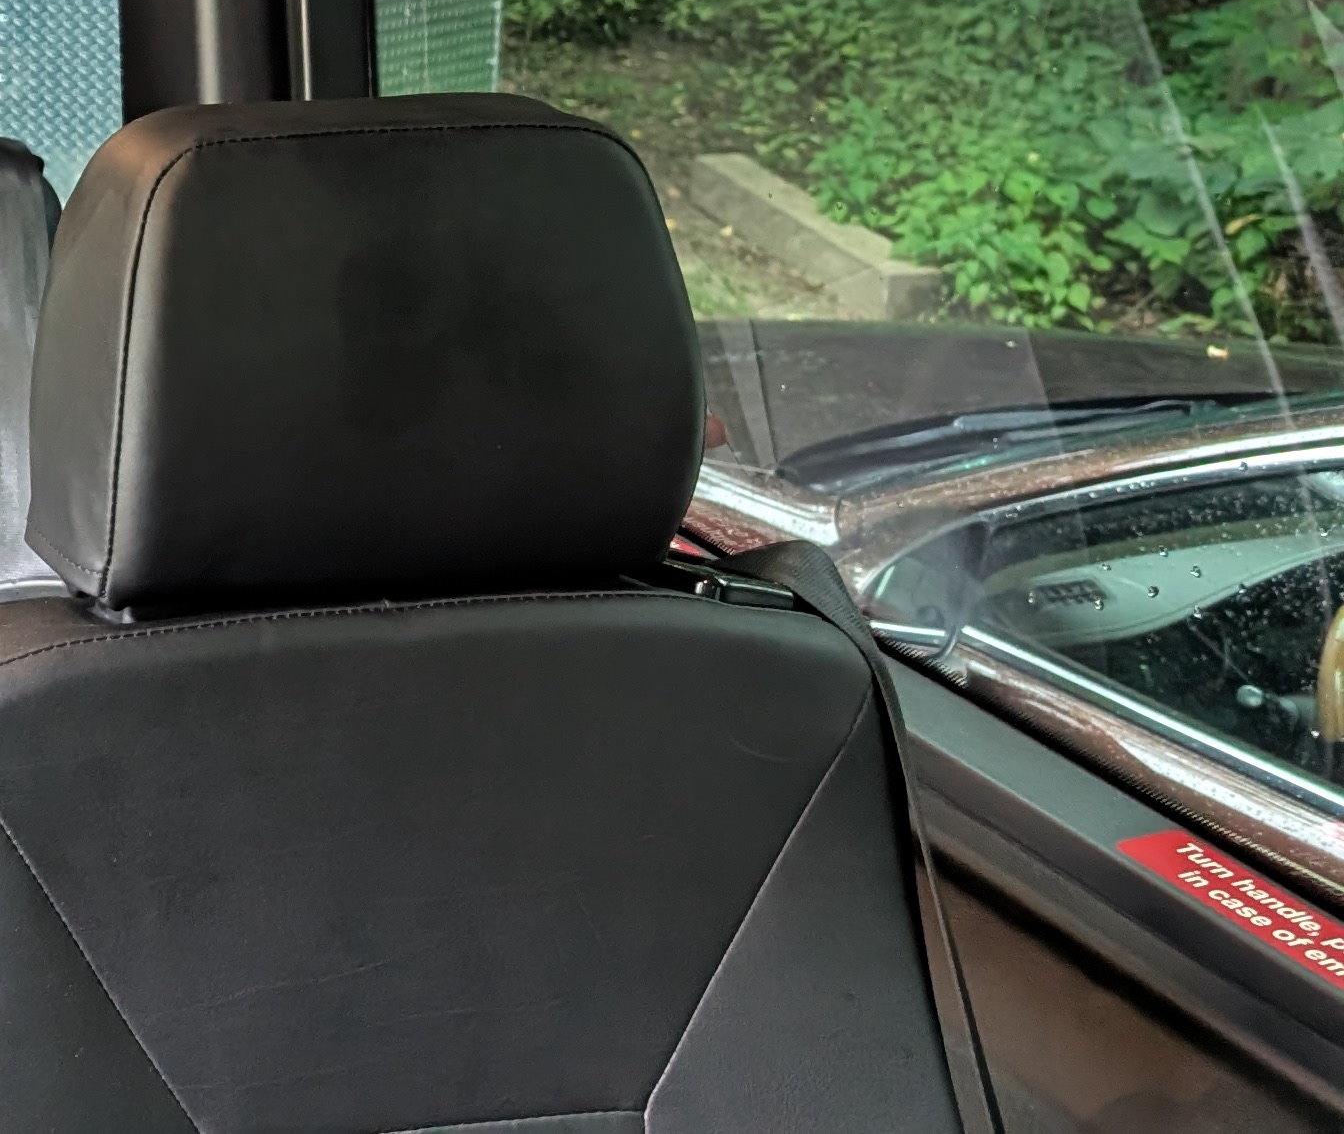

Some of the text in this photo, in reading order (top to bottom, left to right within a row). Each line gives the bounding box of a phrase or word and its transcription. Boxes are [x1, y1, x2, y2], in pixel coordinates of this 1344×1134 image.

[1176, 842, 1234, 879] Turn
[1231, 879, 1320, 937] handle,
[1177, 870, 1209, 888] in
[1208, 889, 1273, 927] case
[1272, 929, 1315, 947] of
